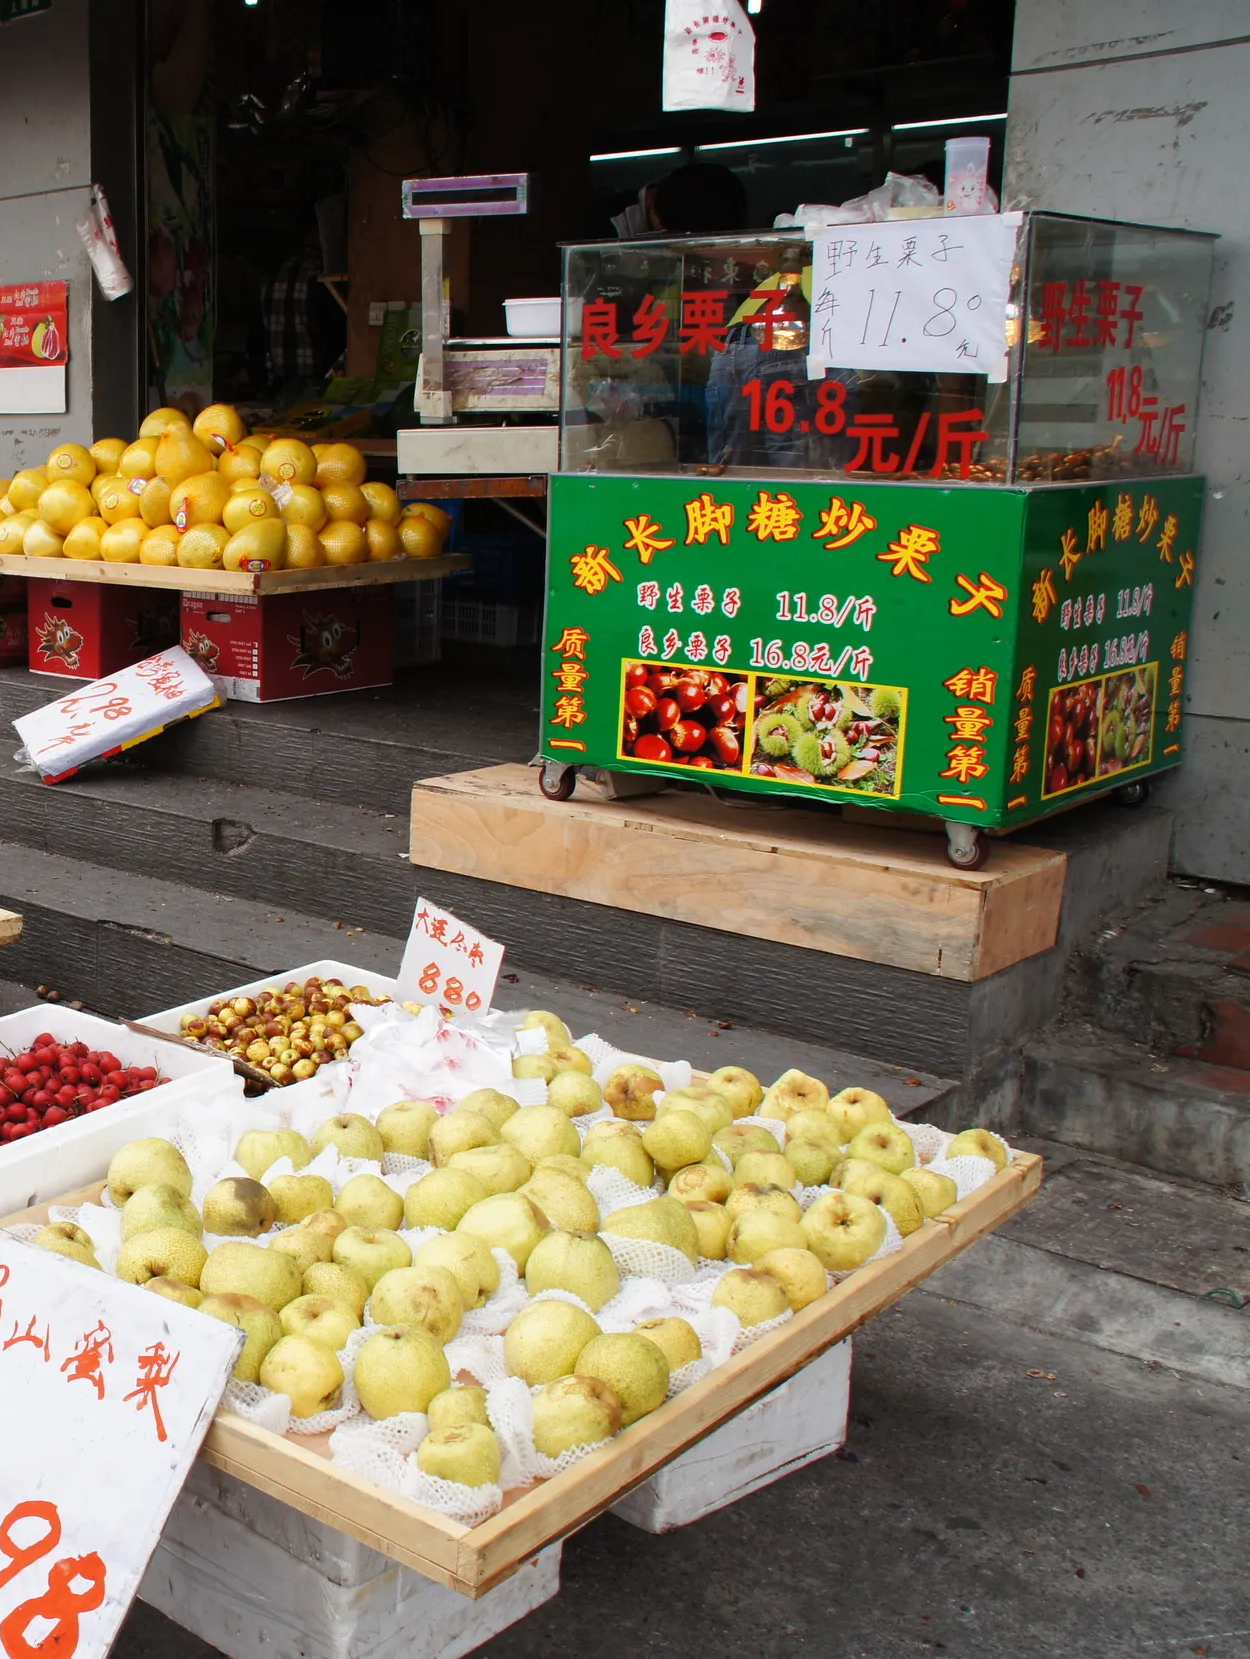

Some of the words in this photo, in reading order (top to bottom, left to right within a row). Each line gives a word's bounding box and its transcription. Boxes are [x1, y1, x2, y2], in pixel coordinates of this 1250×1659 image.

[825, 233, 965, 282] 野生栗子
[581, 289, 797, 361] 良乡栗子
[1039, 278, 1144, 353] 野生栗子
[636, 581, 742, 619] 野生栗子
[776, 590, 877, 633] 11.8/斤
[548, 627, 589, 753] 质量第一
[637, 625, 733, 664] 良乡栗子
[749, 636, 874, 680] 16.8元/斤
[1161, 628, 1188, 757] 销量第一
[937, 667, 998, 812] 销量第一
[1005, 663, 1035, 811] 质量第一
